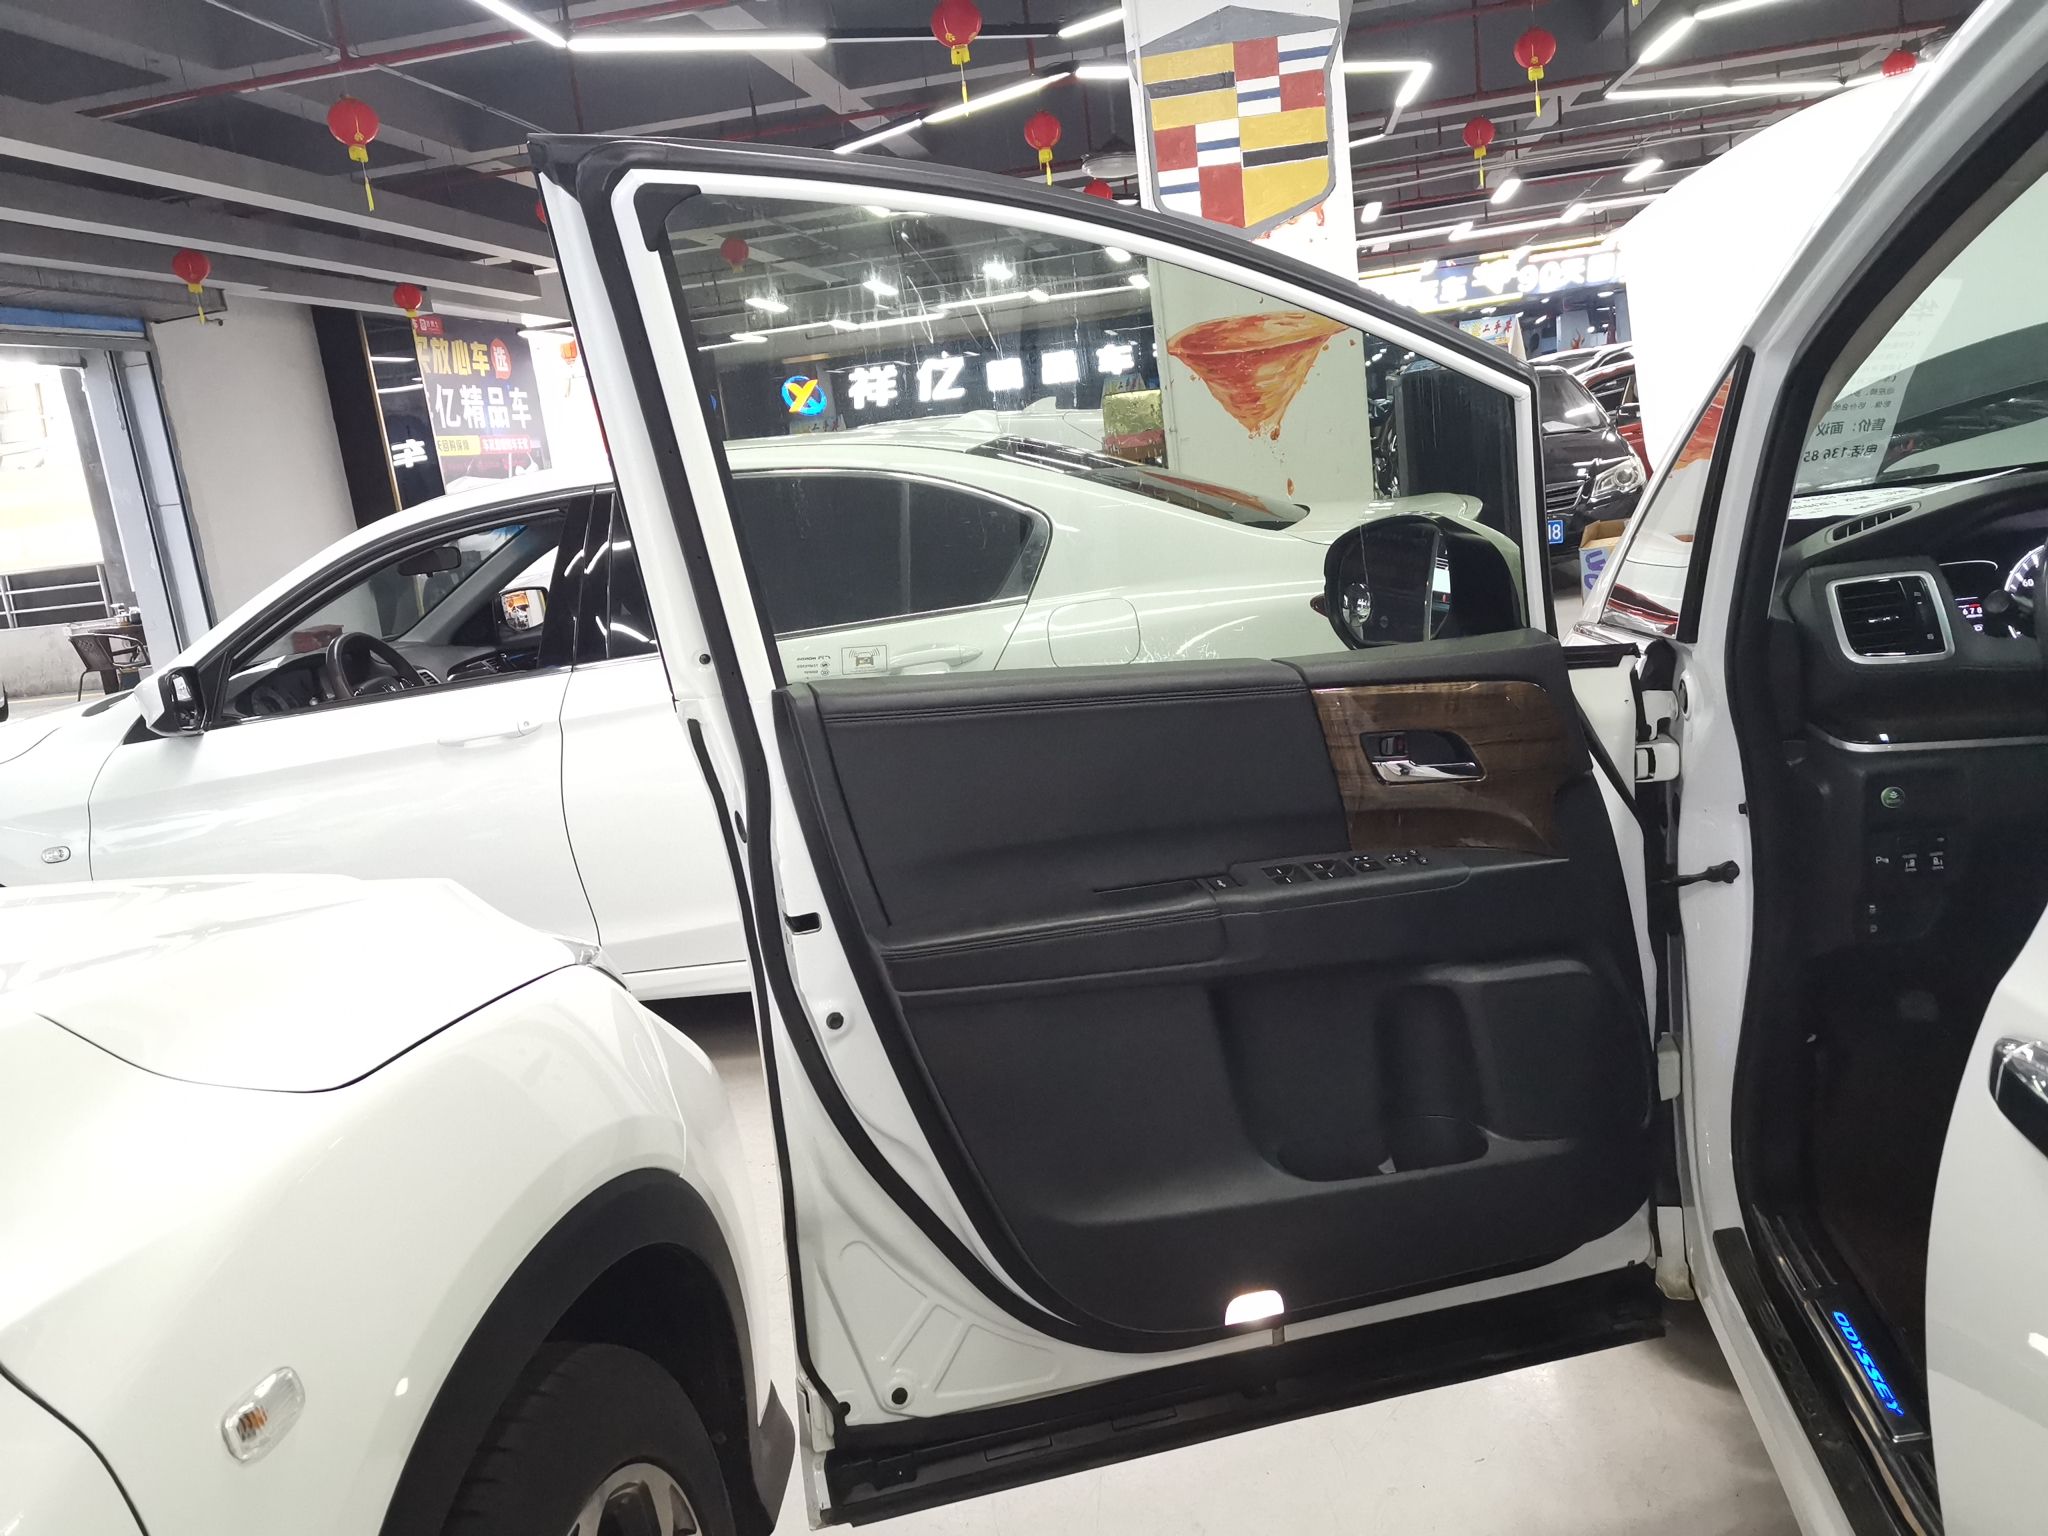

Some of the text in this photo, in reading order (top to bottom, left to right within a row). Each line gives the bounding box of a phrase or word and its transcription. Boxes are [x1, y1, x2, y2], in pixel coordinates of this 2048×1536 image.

[426, 384, 532, 429] 亿精品车
[2022, 578, 2034, 587] 60
[1832, 1311, 1905, 1416] ODYSSEY
